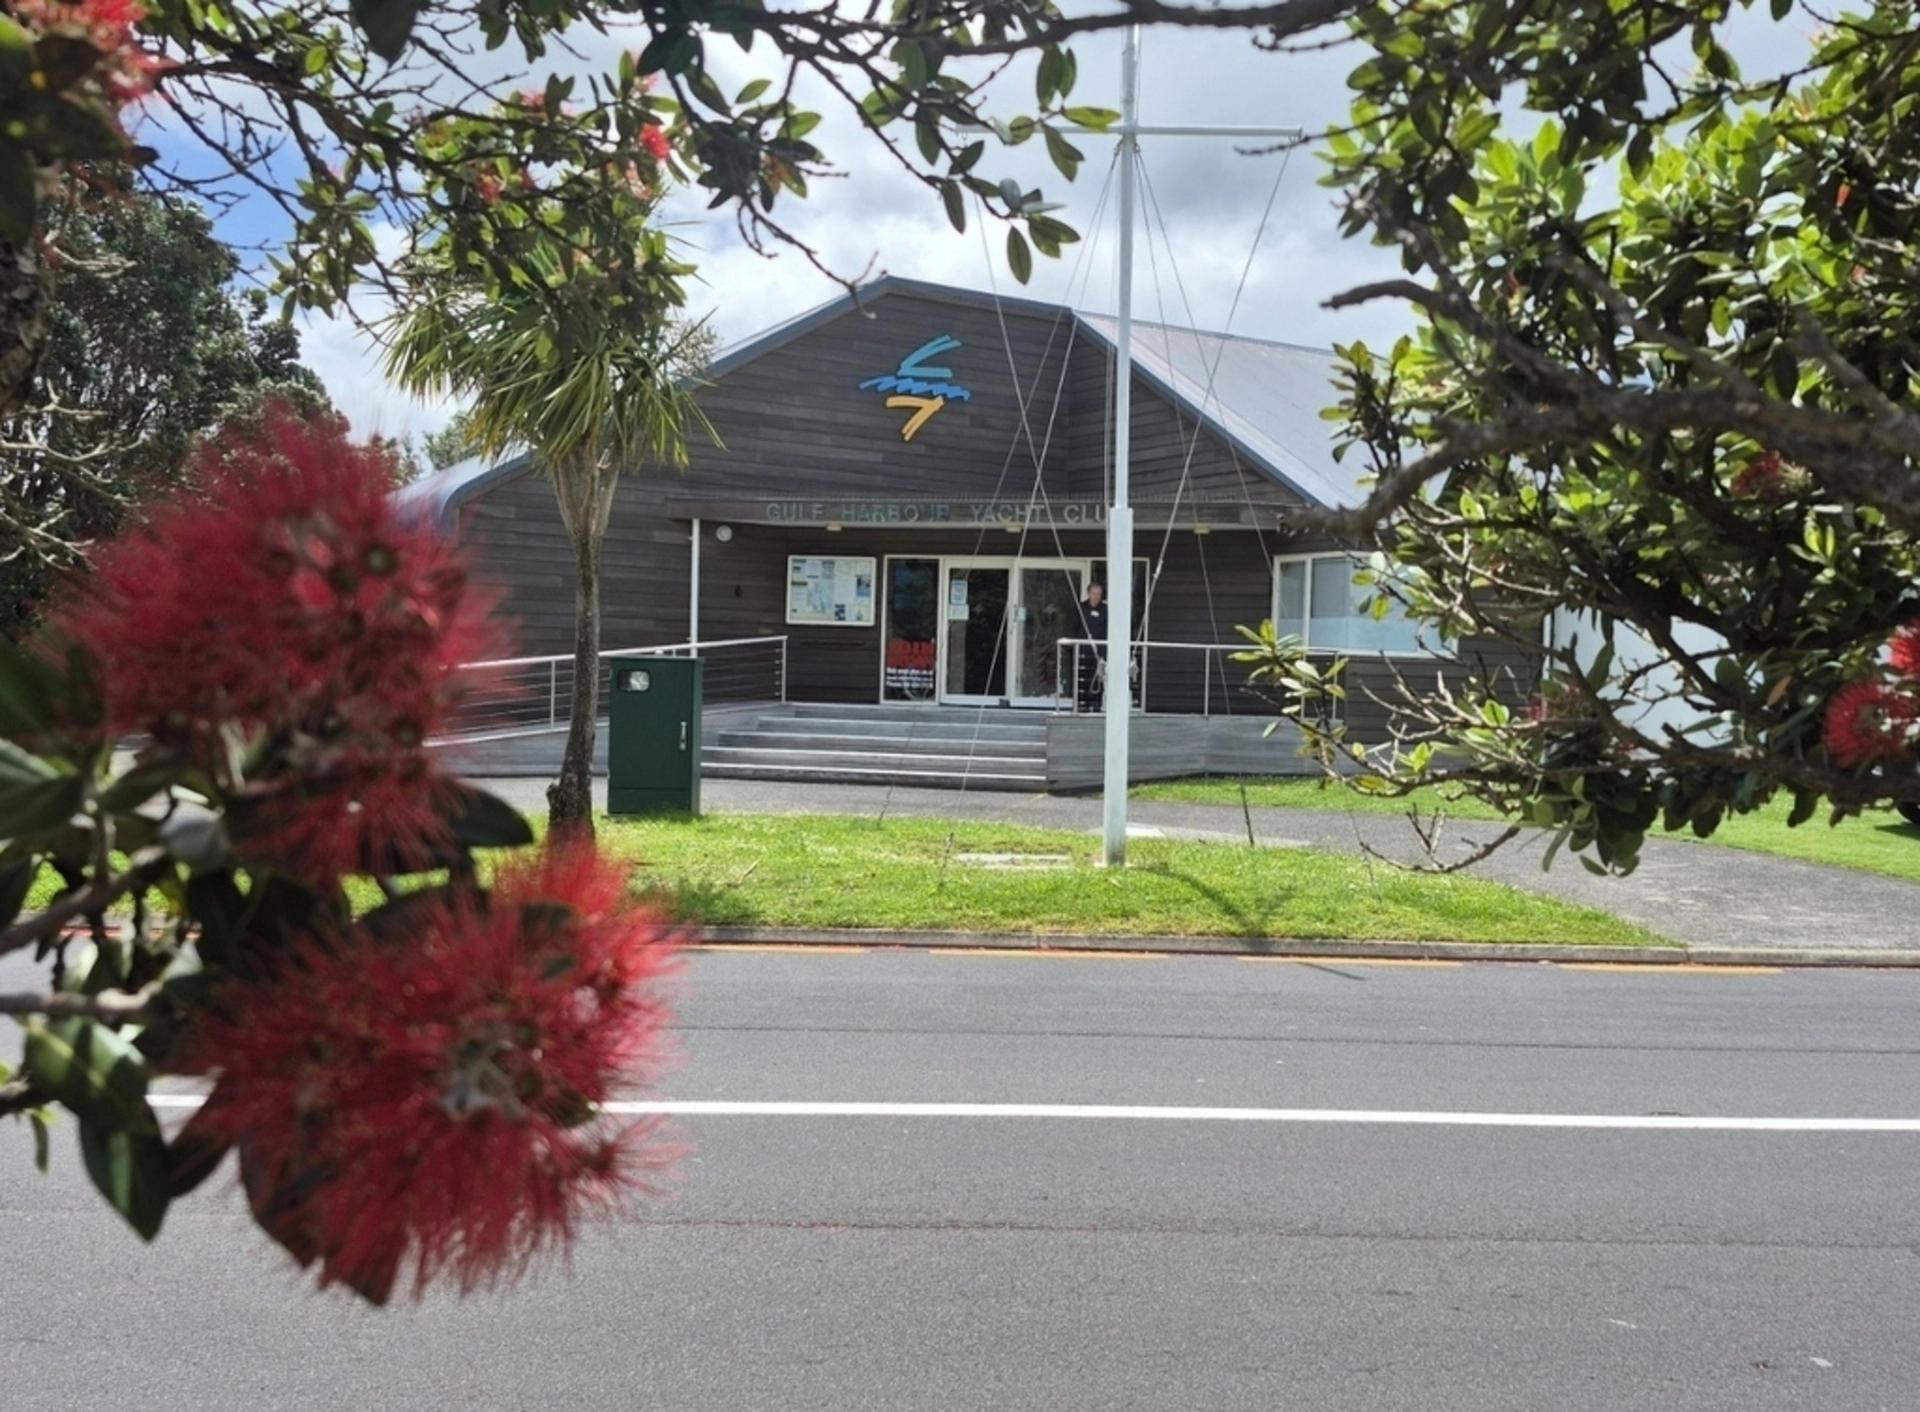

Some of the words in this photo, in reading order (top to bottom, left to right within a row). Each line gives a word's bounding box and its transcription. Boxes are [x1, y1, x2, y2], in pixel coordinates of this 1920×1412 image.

[766, 502, 825, 521] GULF
[970, 504, 1045, 522] YACHT
[1063, 504, 1107, 522] CLU
